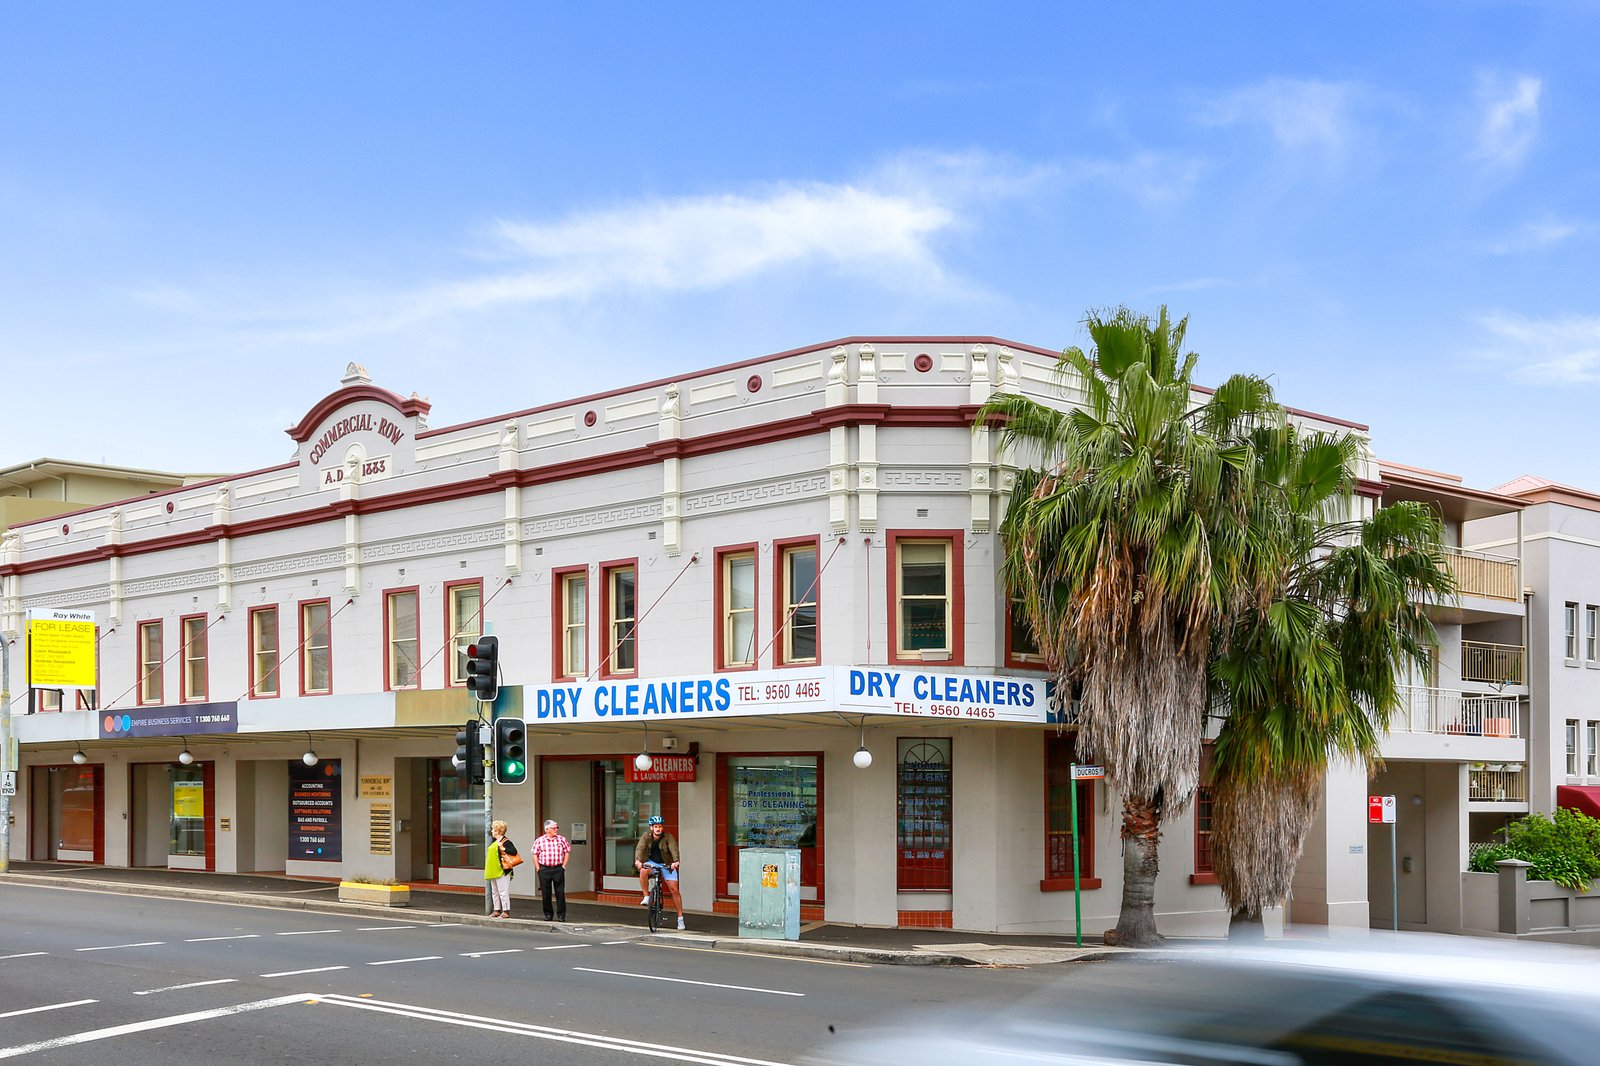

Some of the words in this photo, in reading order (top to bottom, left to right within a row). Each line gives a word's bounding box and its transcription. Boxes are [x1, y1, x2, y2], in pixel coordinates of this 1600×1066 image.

[309, 413, 373, 466] COMMERCIAL
[377, 417, 405, 446] ROW
[361, 460, 386, 477] 1883
[35, 622, 56, 631] FOR
[59, 623, 91, 633] LEASE
[850, 670, 901, 698] DRY
[913, 674, 1035, 707] CLEANERS
[537, 687, 582, 719] DRY
[594, 678, 731, 717] CLEANERS
[738, 686, 760, 701] TEL:
[765, 684, 790, 700] 9560
[795, 682, 820, 698] 4465
[894, 702, 922, 715] TEL:
[930, 704, 960, 716] 9560
[965, 706, 995, 718] 4465
[132, 719, 147, 727] EMPIRE
[148, 718, 169, 726] BUSINESS
[170, 716, 192, 725] SERVICES
[200, 715, 210, 723] 1300
[653, 758, 693, 772] CLEANERS
[762, 800, 805, 808] CLEANING
